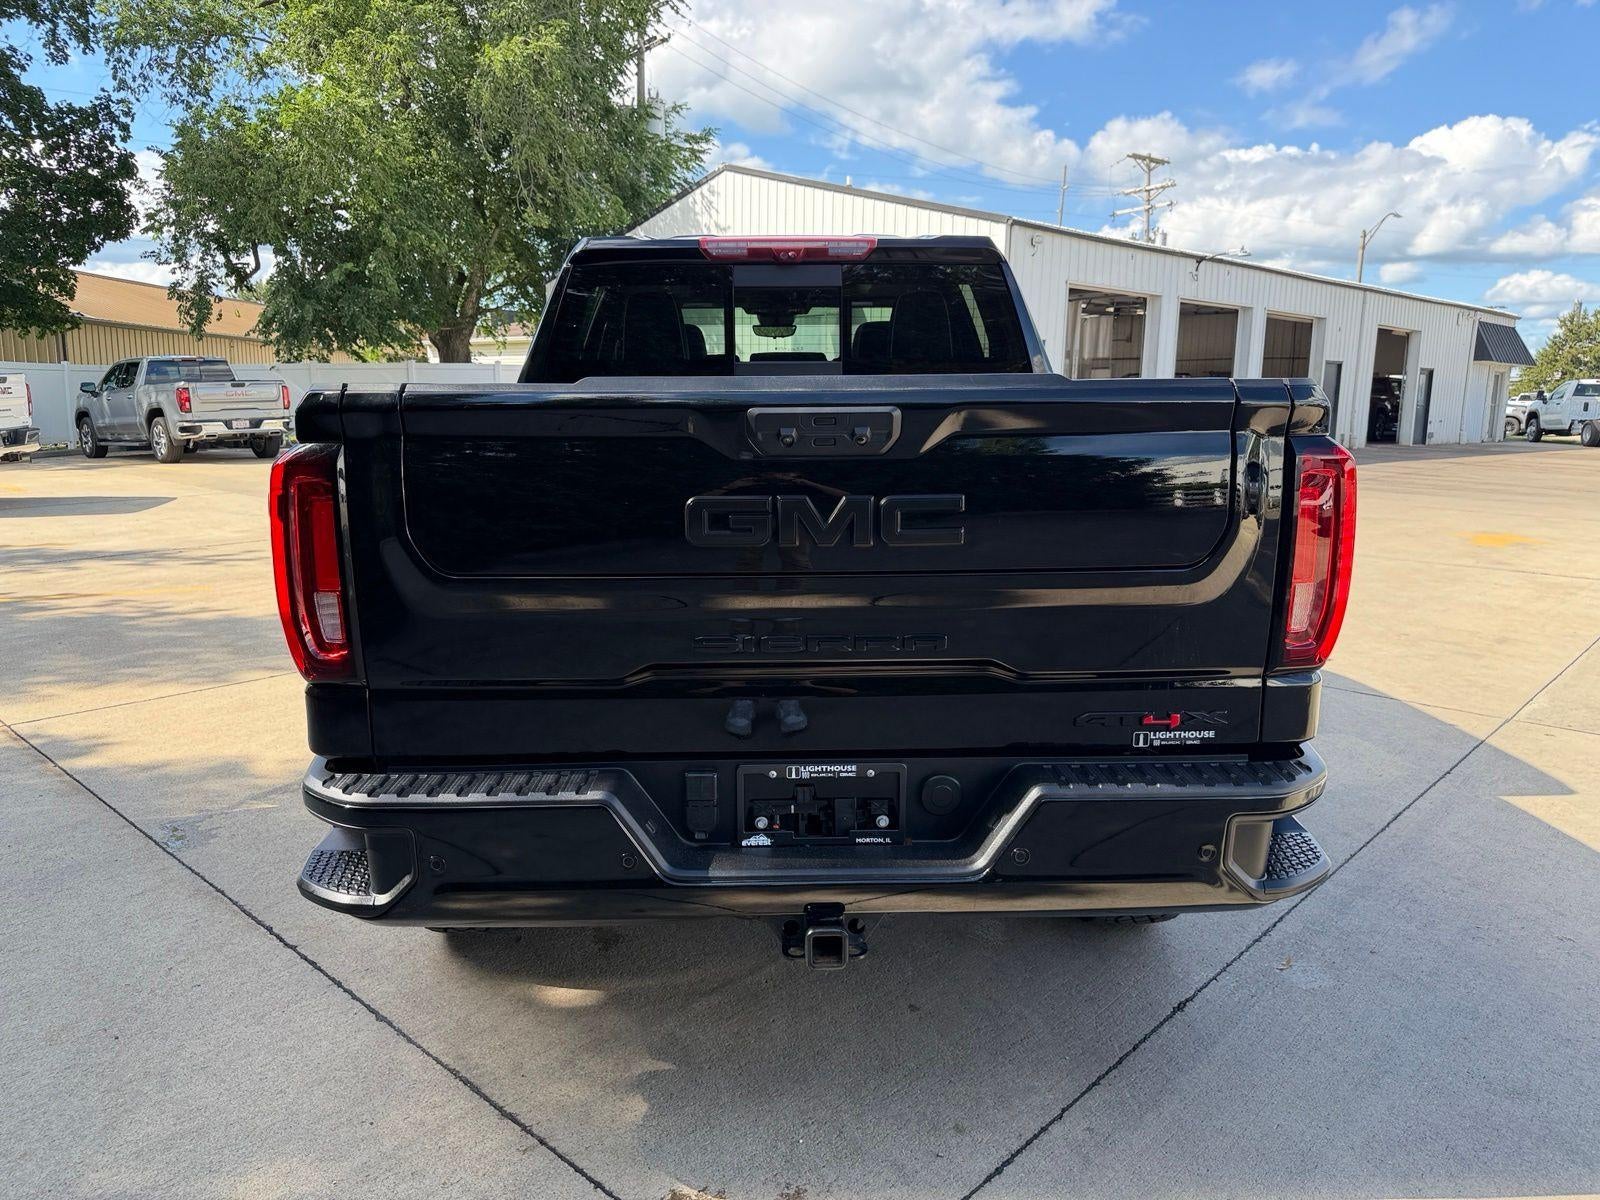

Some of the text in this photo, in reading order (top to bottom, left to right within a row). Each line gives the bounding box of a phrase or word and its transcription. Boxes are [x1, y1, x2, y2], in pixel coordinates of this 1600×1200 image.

[685, 495, 966, 548] GMC
[694, 634, 949, 653] SIERRA
[1074, 711, 1230, 729] AT4X
[1150, 730, 1216, 739] LIGHTHOUSE
[741, 838, 772, 846] everest
